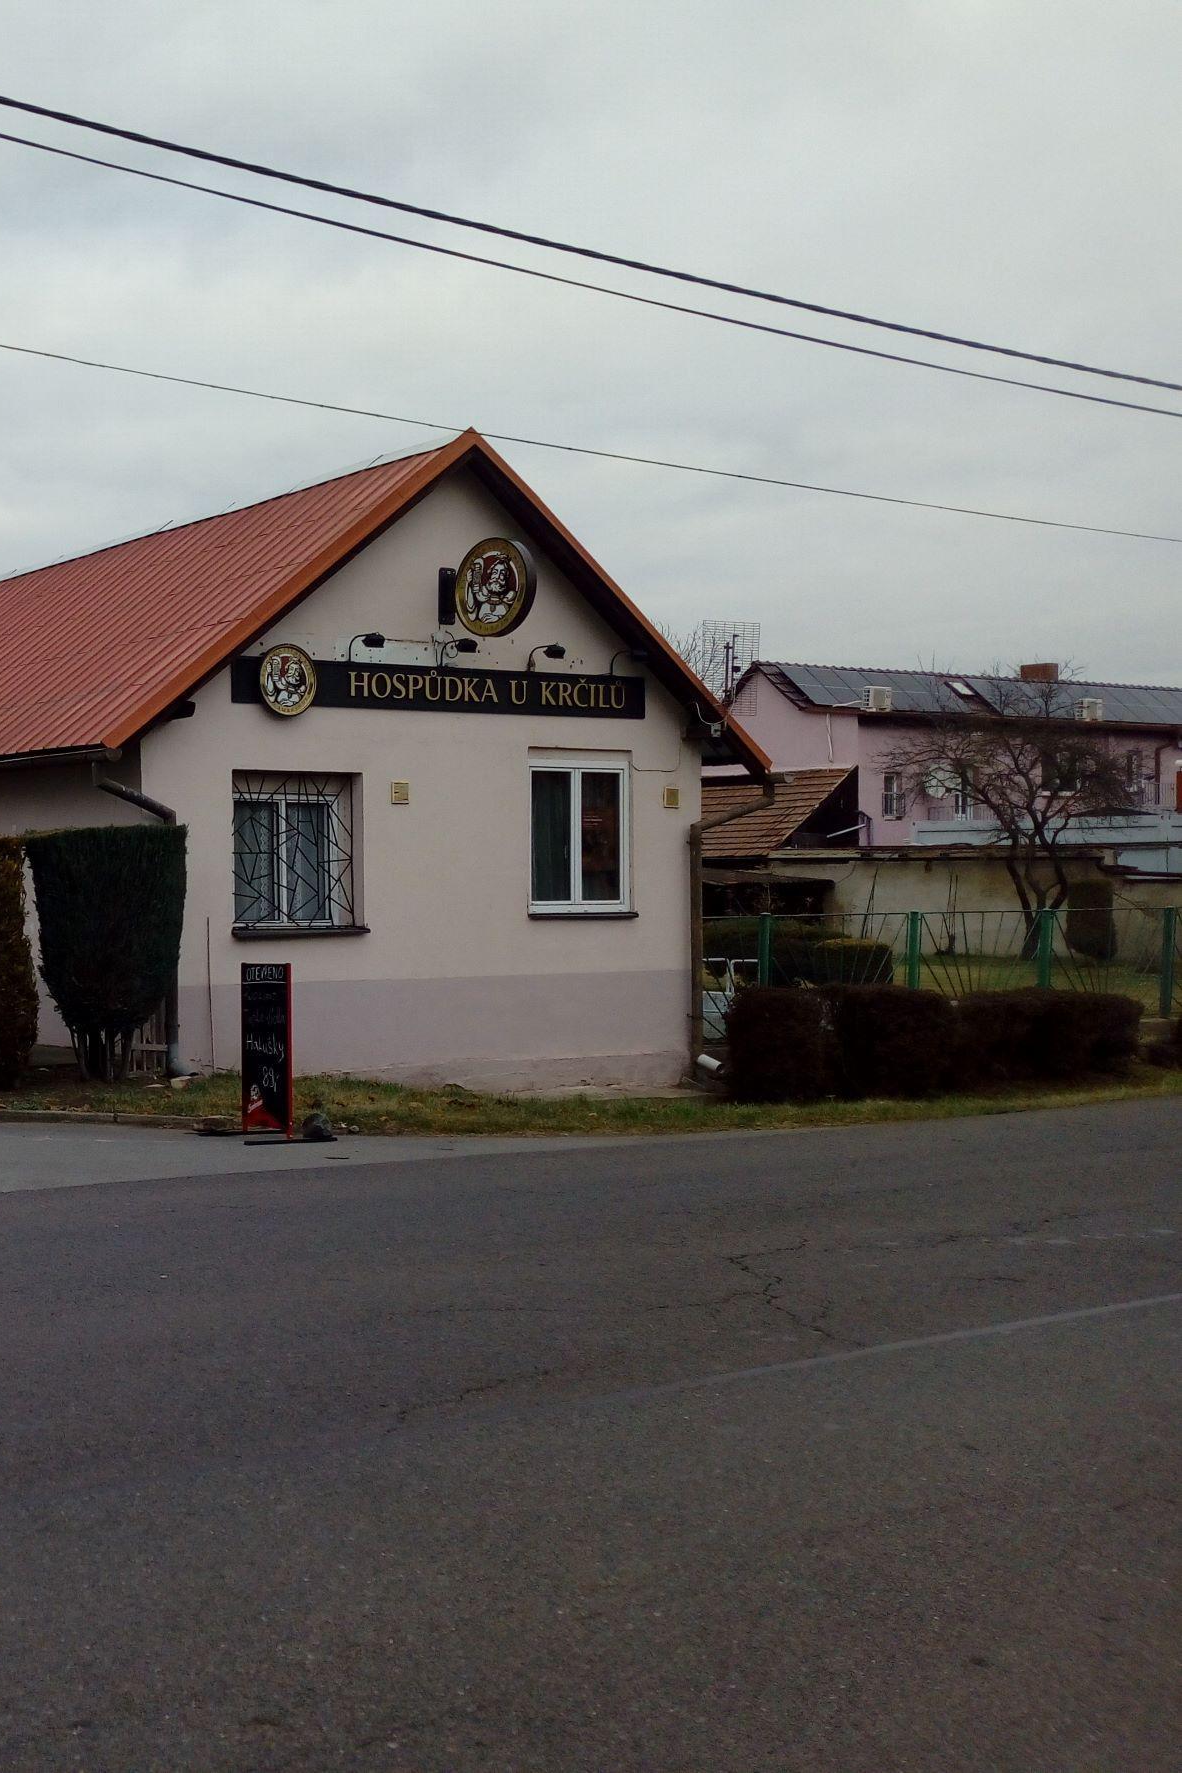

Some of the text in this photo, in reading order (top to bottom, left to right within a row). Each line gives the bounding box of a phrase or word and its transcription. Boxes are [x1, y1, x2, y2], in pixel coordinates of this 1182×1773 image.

[348, 670, 625, 709] HOSPŮDKA U KRČILŮ
